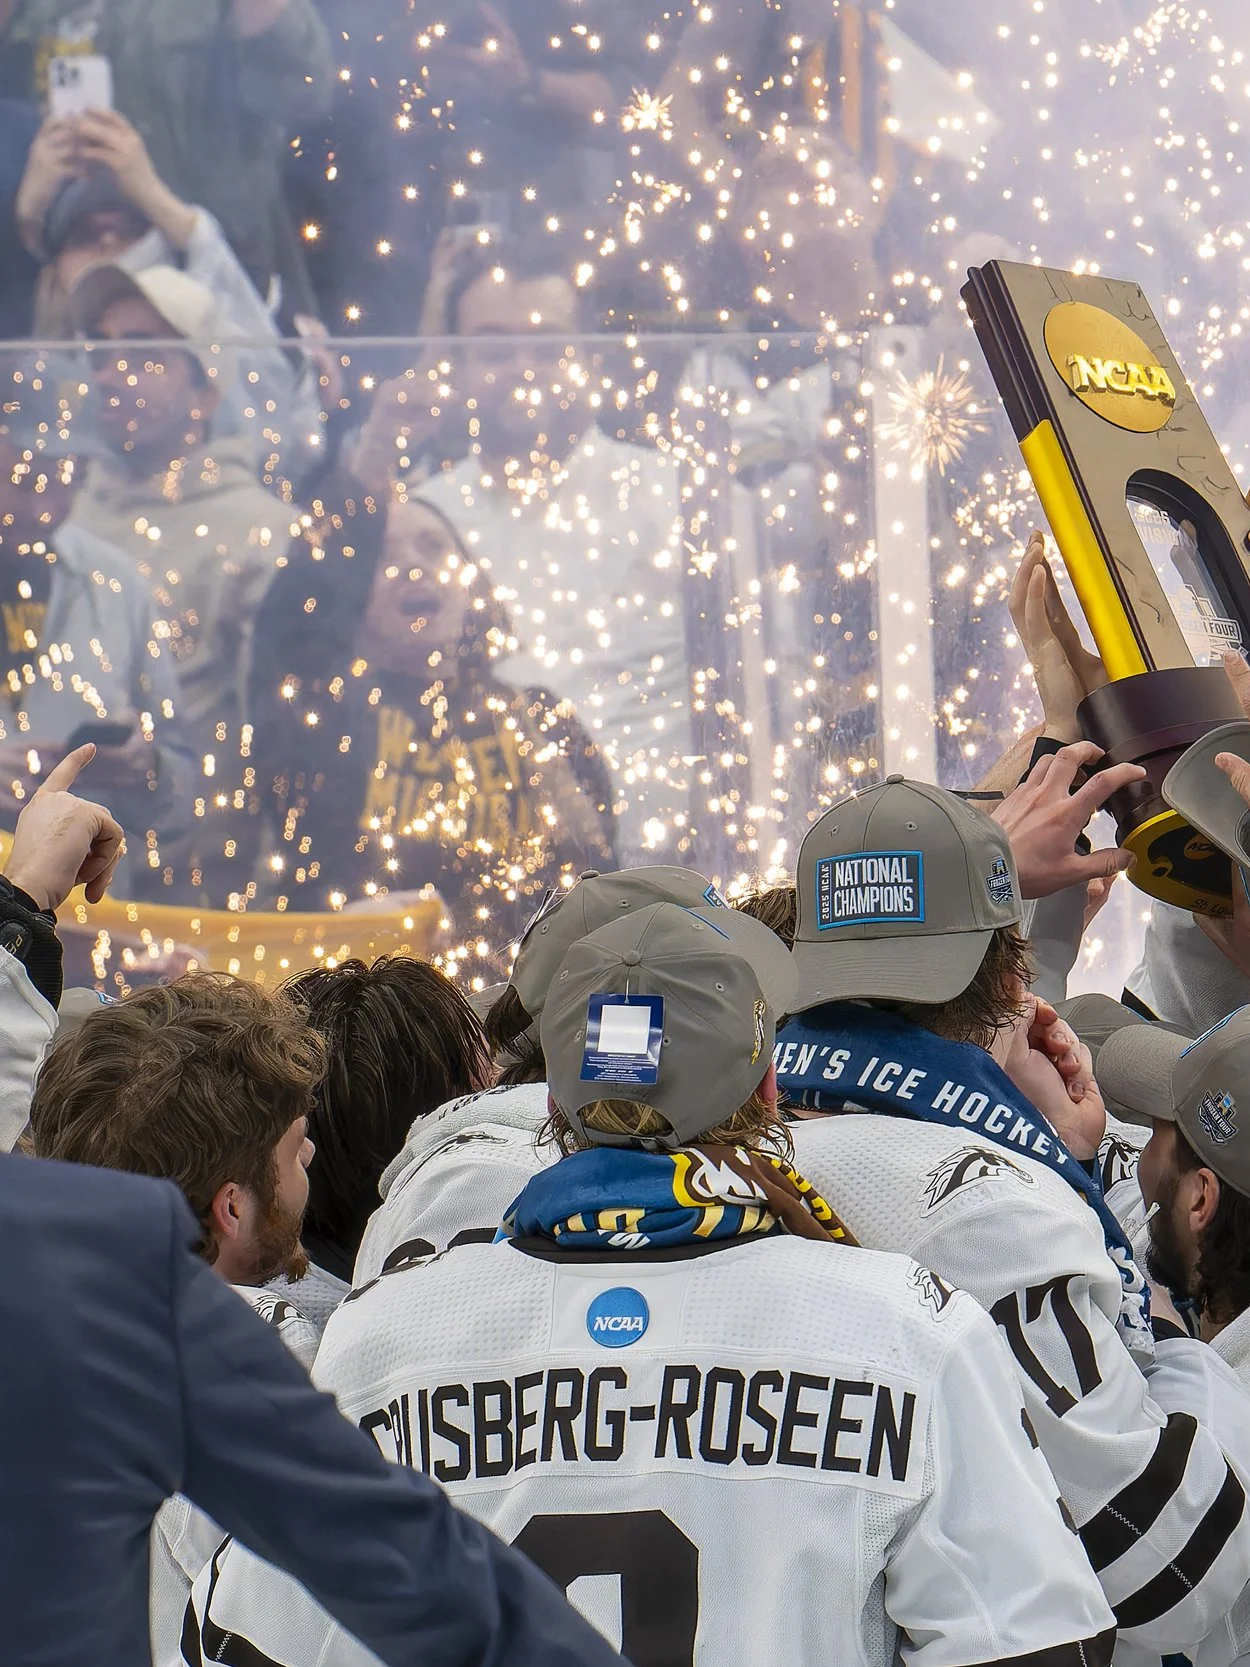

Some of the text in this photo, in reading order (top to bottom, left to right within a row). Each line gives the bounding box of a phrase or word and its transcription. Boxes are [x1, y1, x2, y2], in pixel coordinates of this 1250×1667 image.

[1067, 353, 1175, 408] NCAA
[1208, 622, 1237, 637] FOUR
[834, 857, 914, 888] NATIONAL
[821, 895, 830, 919] 2025
[833, 885, 914, 917] CHAMPIONS
[856, 1056, 928, 1100] ICE
[931, 1080, 1070, 1166] HOCKEY
[1216, 1117, 1232, 1135] FOUR
[593, 1316, 643, 1331] NCAA
[989, 1273, 1103, 1419] 17
